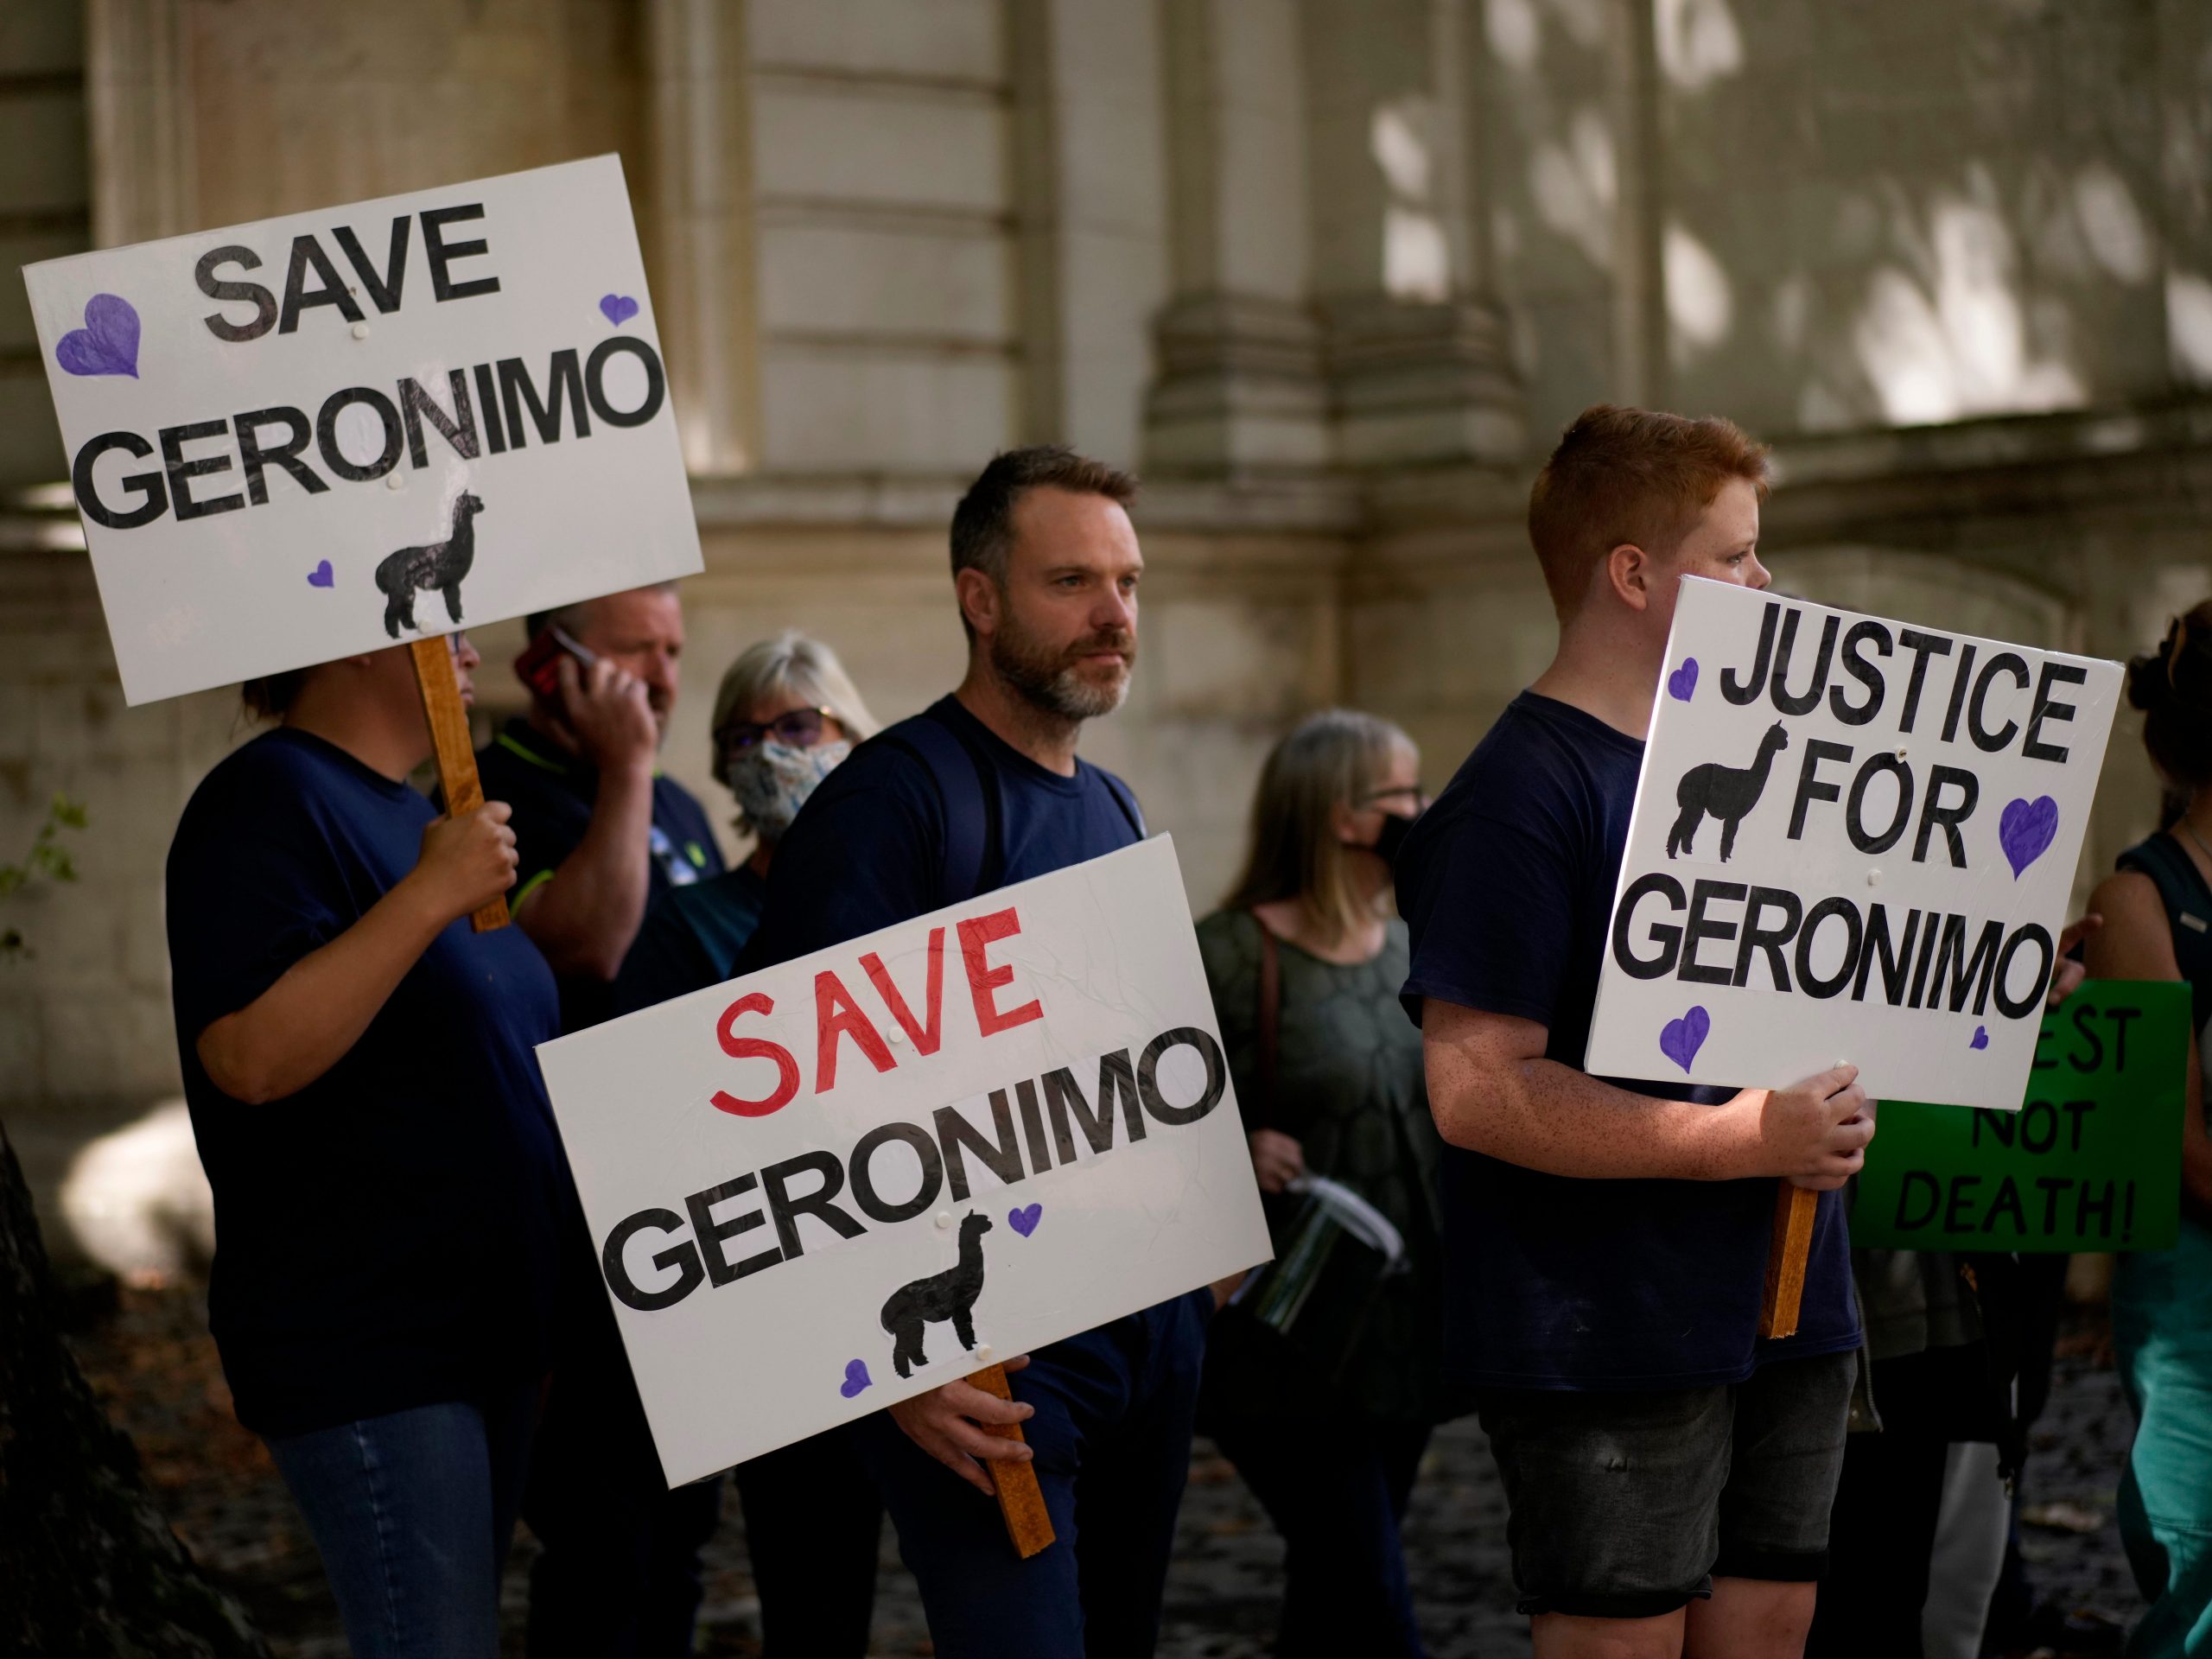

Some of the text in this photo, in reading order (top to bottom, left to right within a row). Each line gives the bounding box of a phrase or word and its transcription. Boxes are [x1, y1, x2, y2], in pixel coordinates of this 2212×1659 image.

[194, 202, 501, 343] SAVE
[71, 335, 666, 530] GERONIMO
[1719, 601, 2088, 765] JUSTICE
[1786, 738, 1980, 869] FOR
[709, 906, 1045, 1118] SAVE
[1611, 872, 2055, 1020] GERONIMO
[601, 1027, 1226, 1312] GERONIMO
[1972, 1100, 2097, 1155] NOT
[1893, 1169, 2136, 1244] DEATH!
